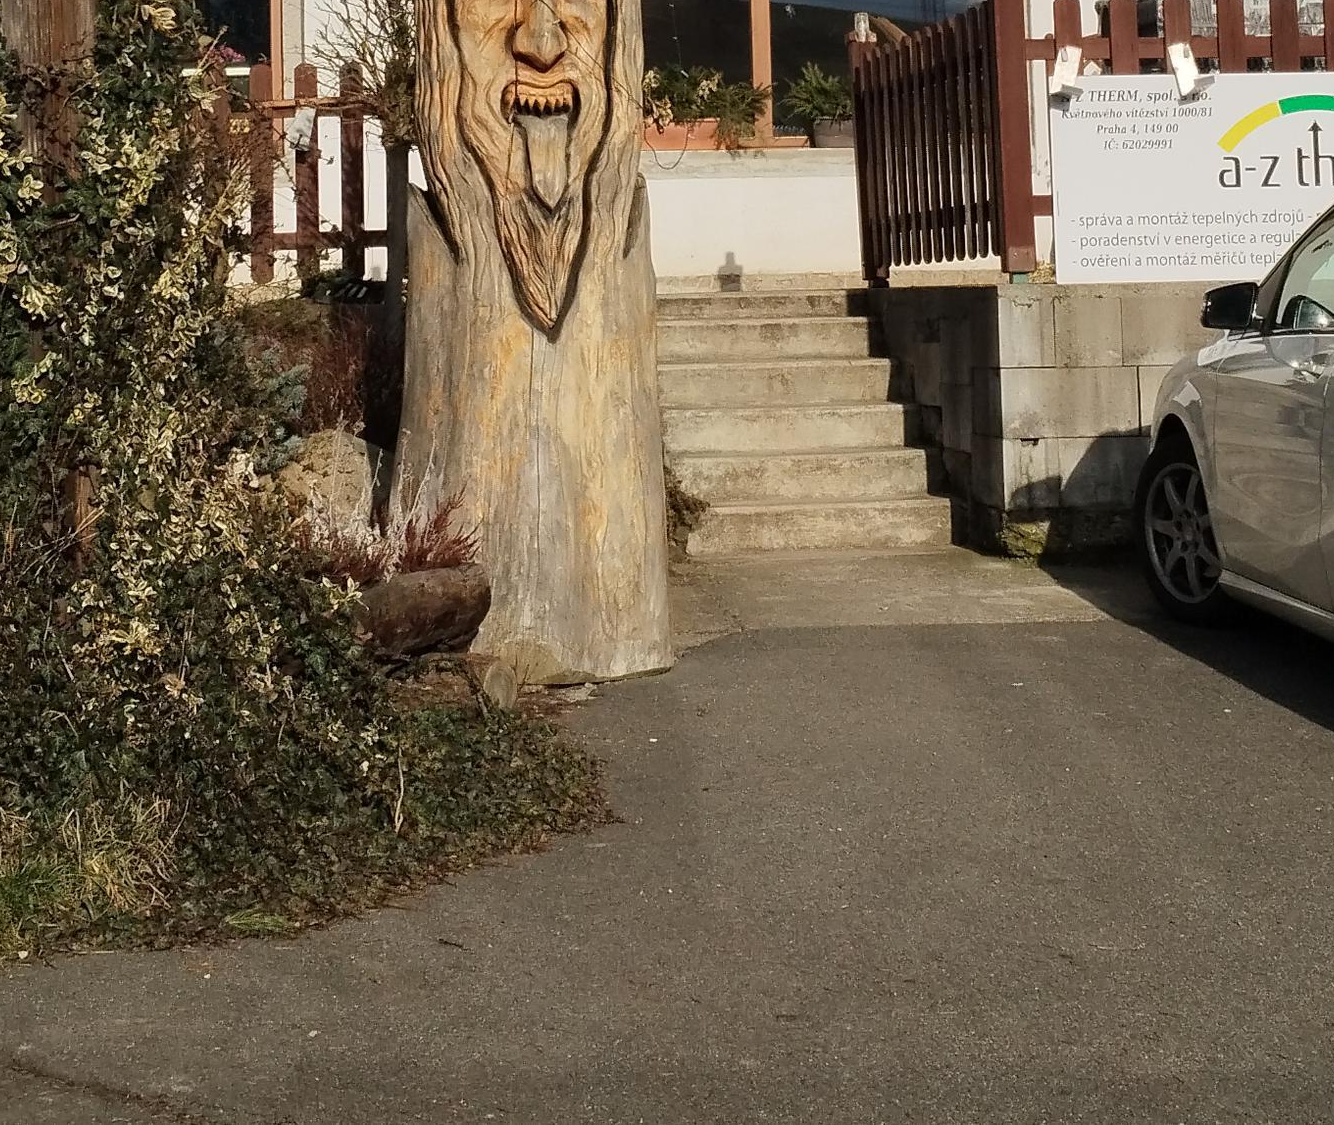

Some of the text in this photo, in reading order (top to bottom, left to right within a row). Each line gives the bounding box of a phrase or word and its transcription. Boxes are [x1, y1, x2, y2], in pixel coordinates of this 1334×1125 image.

[1087, 89, 1142, 103] THERM,
[1146, 89, 1177, 105] spol.
[1172, 106, 1213, 118] 1000/81
[1096, 123, 1179, 136] Praha 4, 149 00
[1103, 138, 1119, 150] IČ:
[1218, 155, 1281, 188] a-z
[1078, 212, 1123, 229] správa
[1126, 215, 1134, 225] a
[1137, 211, 1188, 225] montáž
[1192, 210, 1258, 228] tepelných
[1261, 208, 1304, 227] zdrojů
[1080, 231, 1160, 250] poradenství
[1163, 235, 1171, 245] v
[1174, 232, 1246, 249] energetice
[1249, 233, 1257, 244] a
[1260, 229, 1302, 247] regul
[1080, 253, 1131, 268] ověření
[1135, 257, 1142, 267] a
[1146, 252, 1196, 267] montáž
[1200, 251, 1247, 266] měřičů
